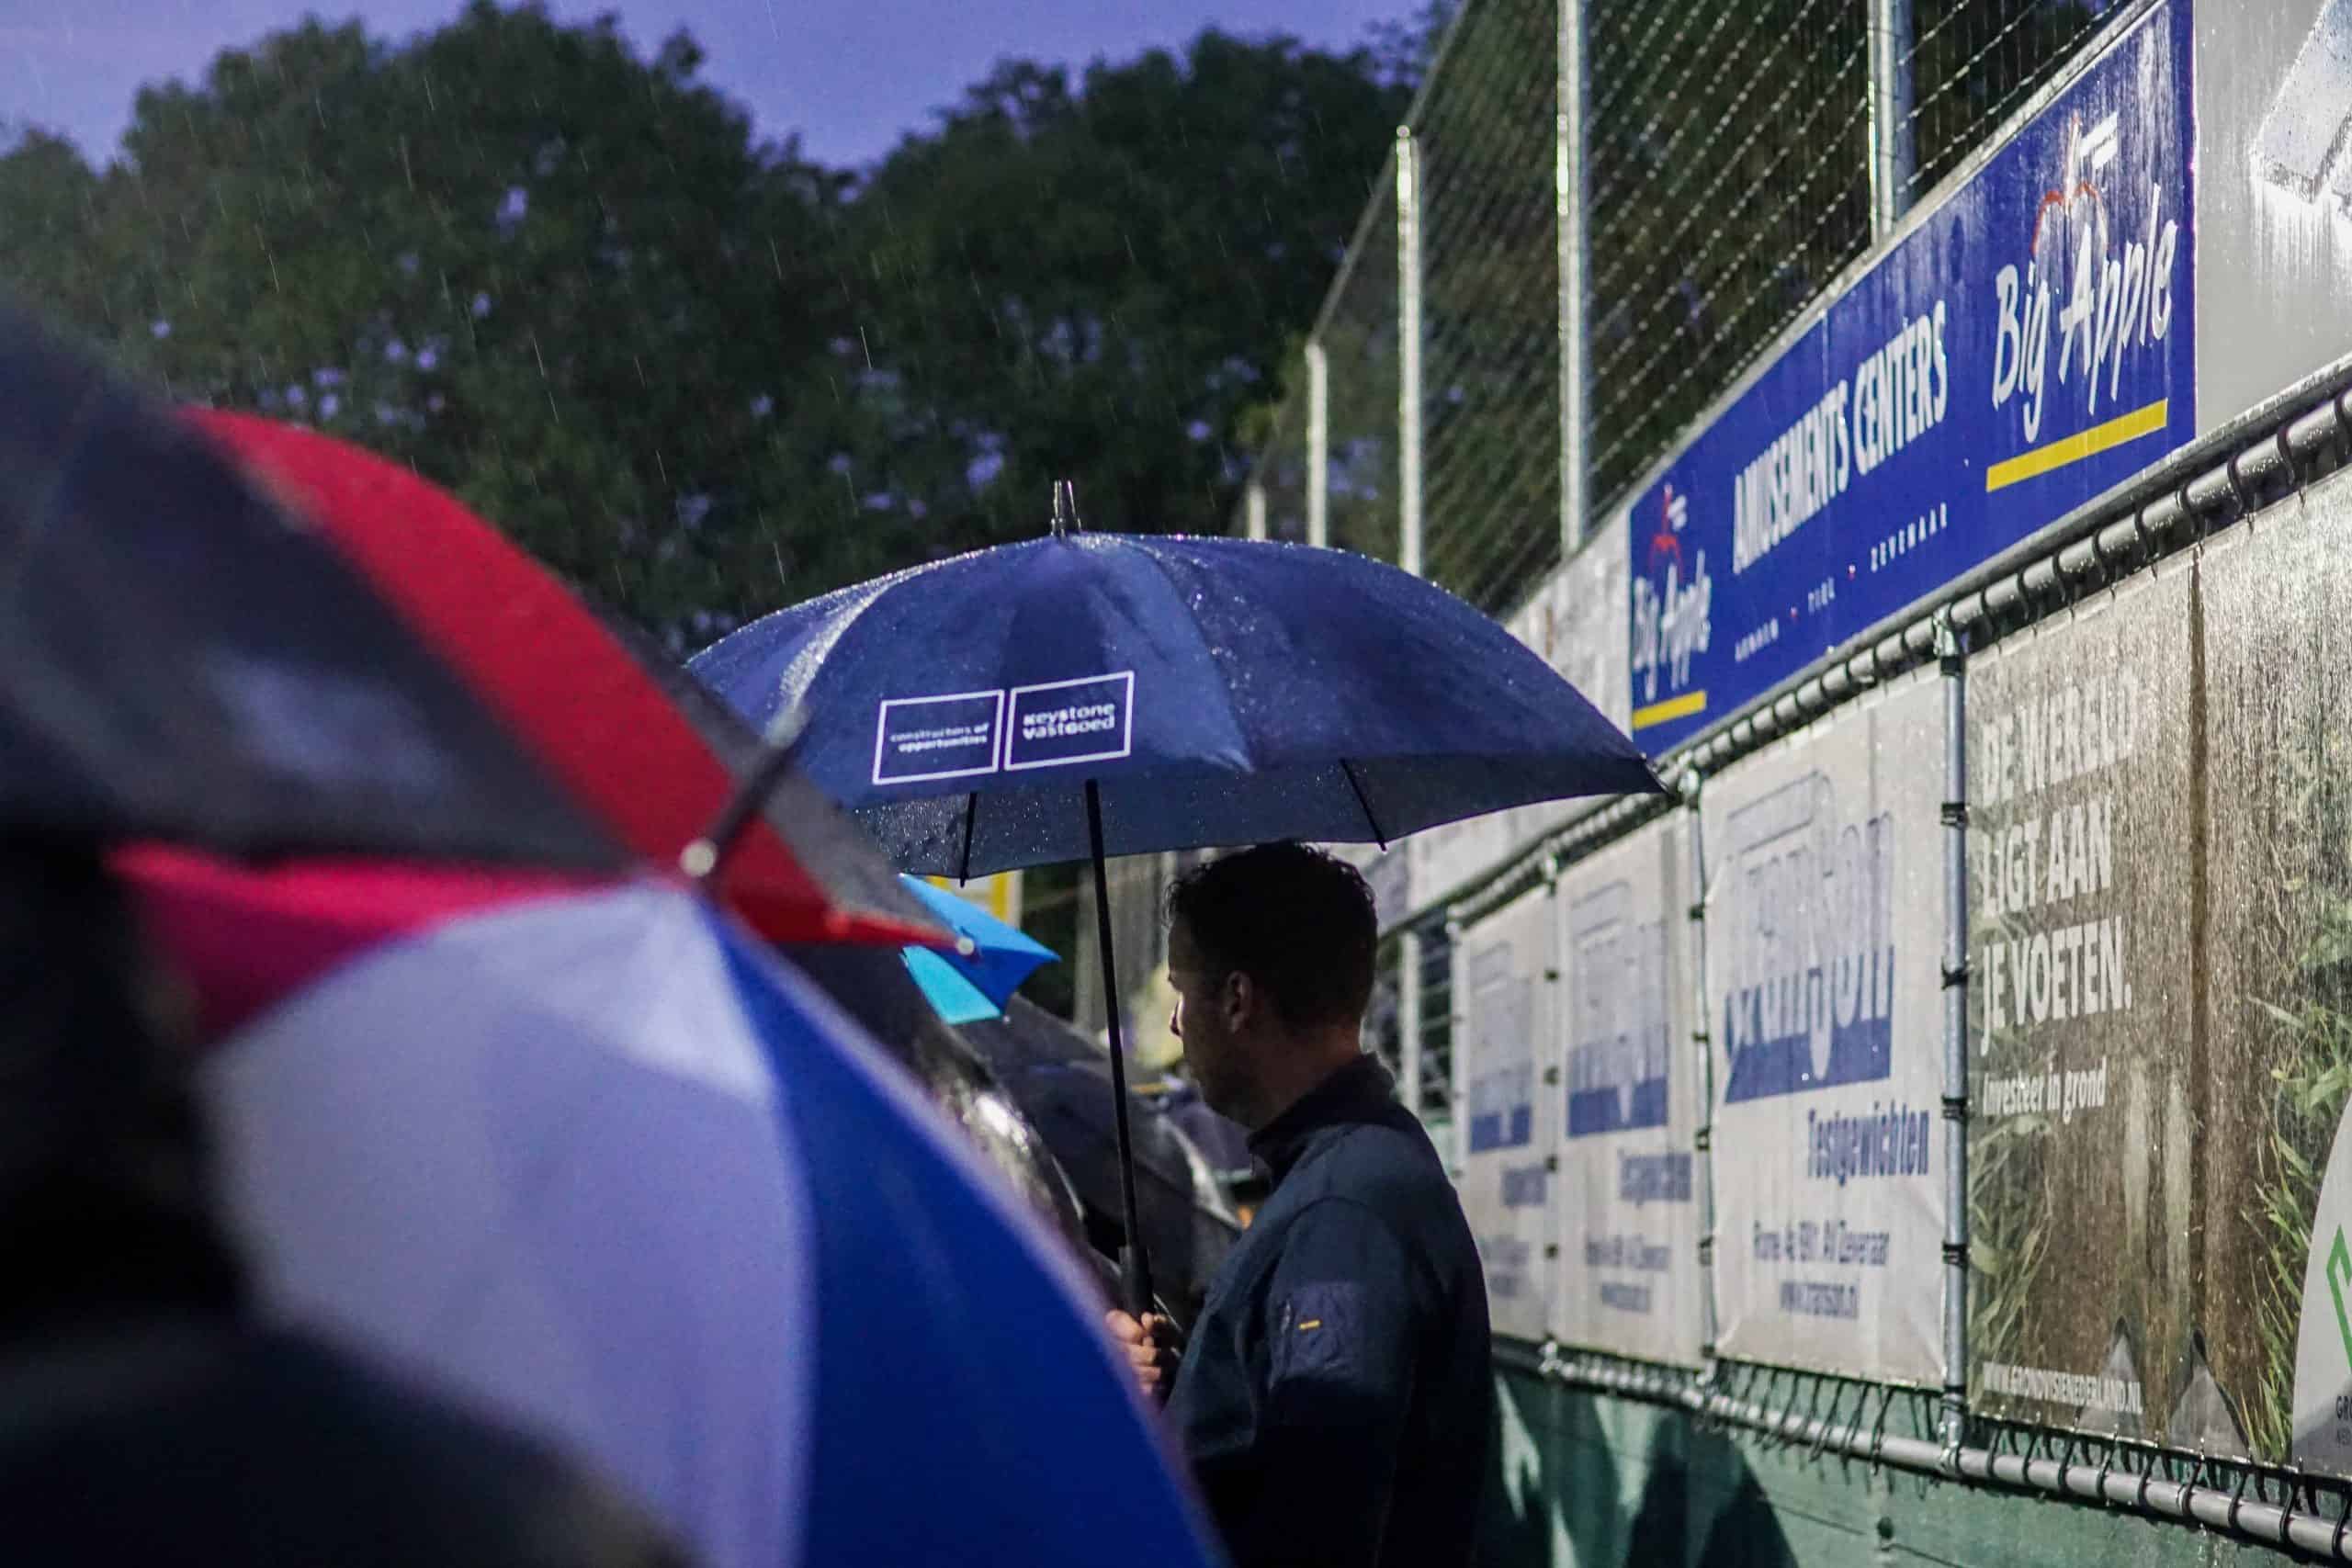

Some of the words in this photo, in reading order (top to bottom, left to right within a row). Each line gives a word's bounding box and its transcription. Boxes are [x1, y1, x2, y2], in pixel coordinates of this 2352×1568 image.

[1992, 260, 2051, 445] Big
[2058, 183, 2178, 416] Apple
[1733, 378, 1849, 575] AMUSEMENTS
[1853, 299, 1948, 477] CENTERS
[1634, 576, 1660, 702] Big
[1659, 548, 1712, 690] Apple
[1982, 825, 2037, 917] LIGT
[2046, 795, 2112, 905] AAN
[1980, 943, 2007, 1056] JE
[2010, 917, 2132, 1025] VOETEN.
[1983, 1069, 2045, 1117] Investeer
[2047, 1061, 2061, 1111] in
[2063, 1055, 2107, 1124] grond
